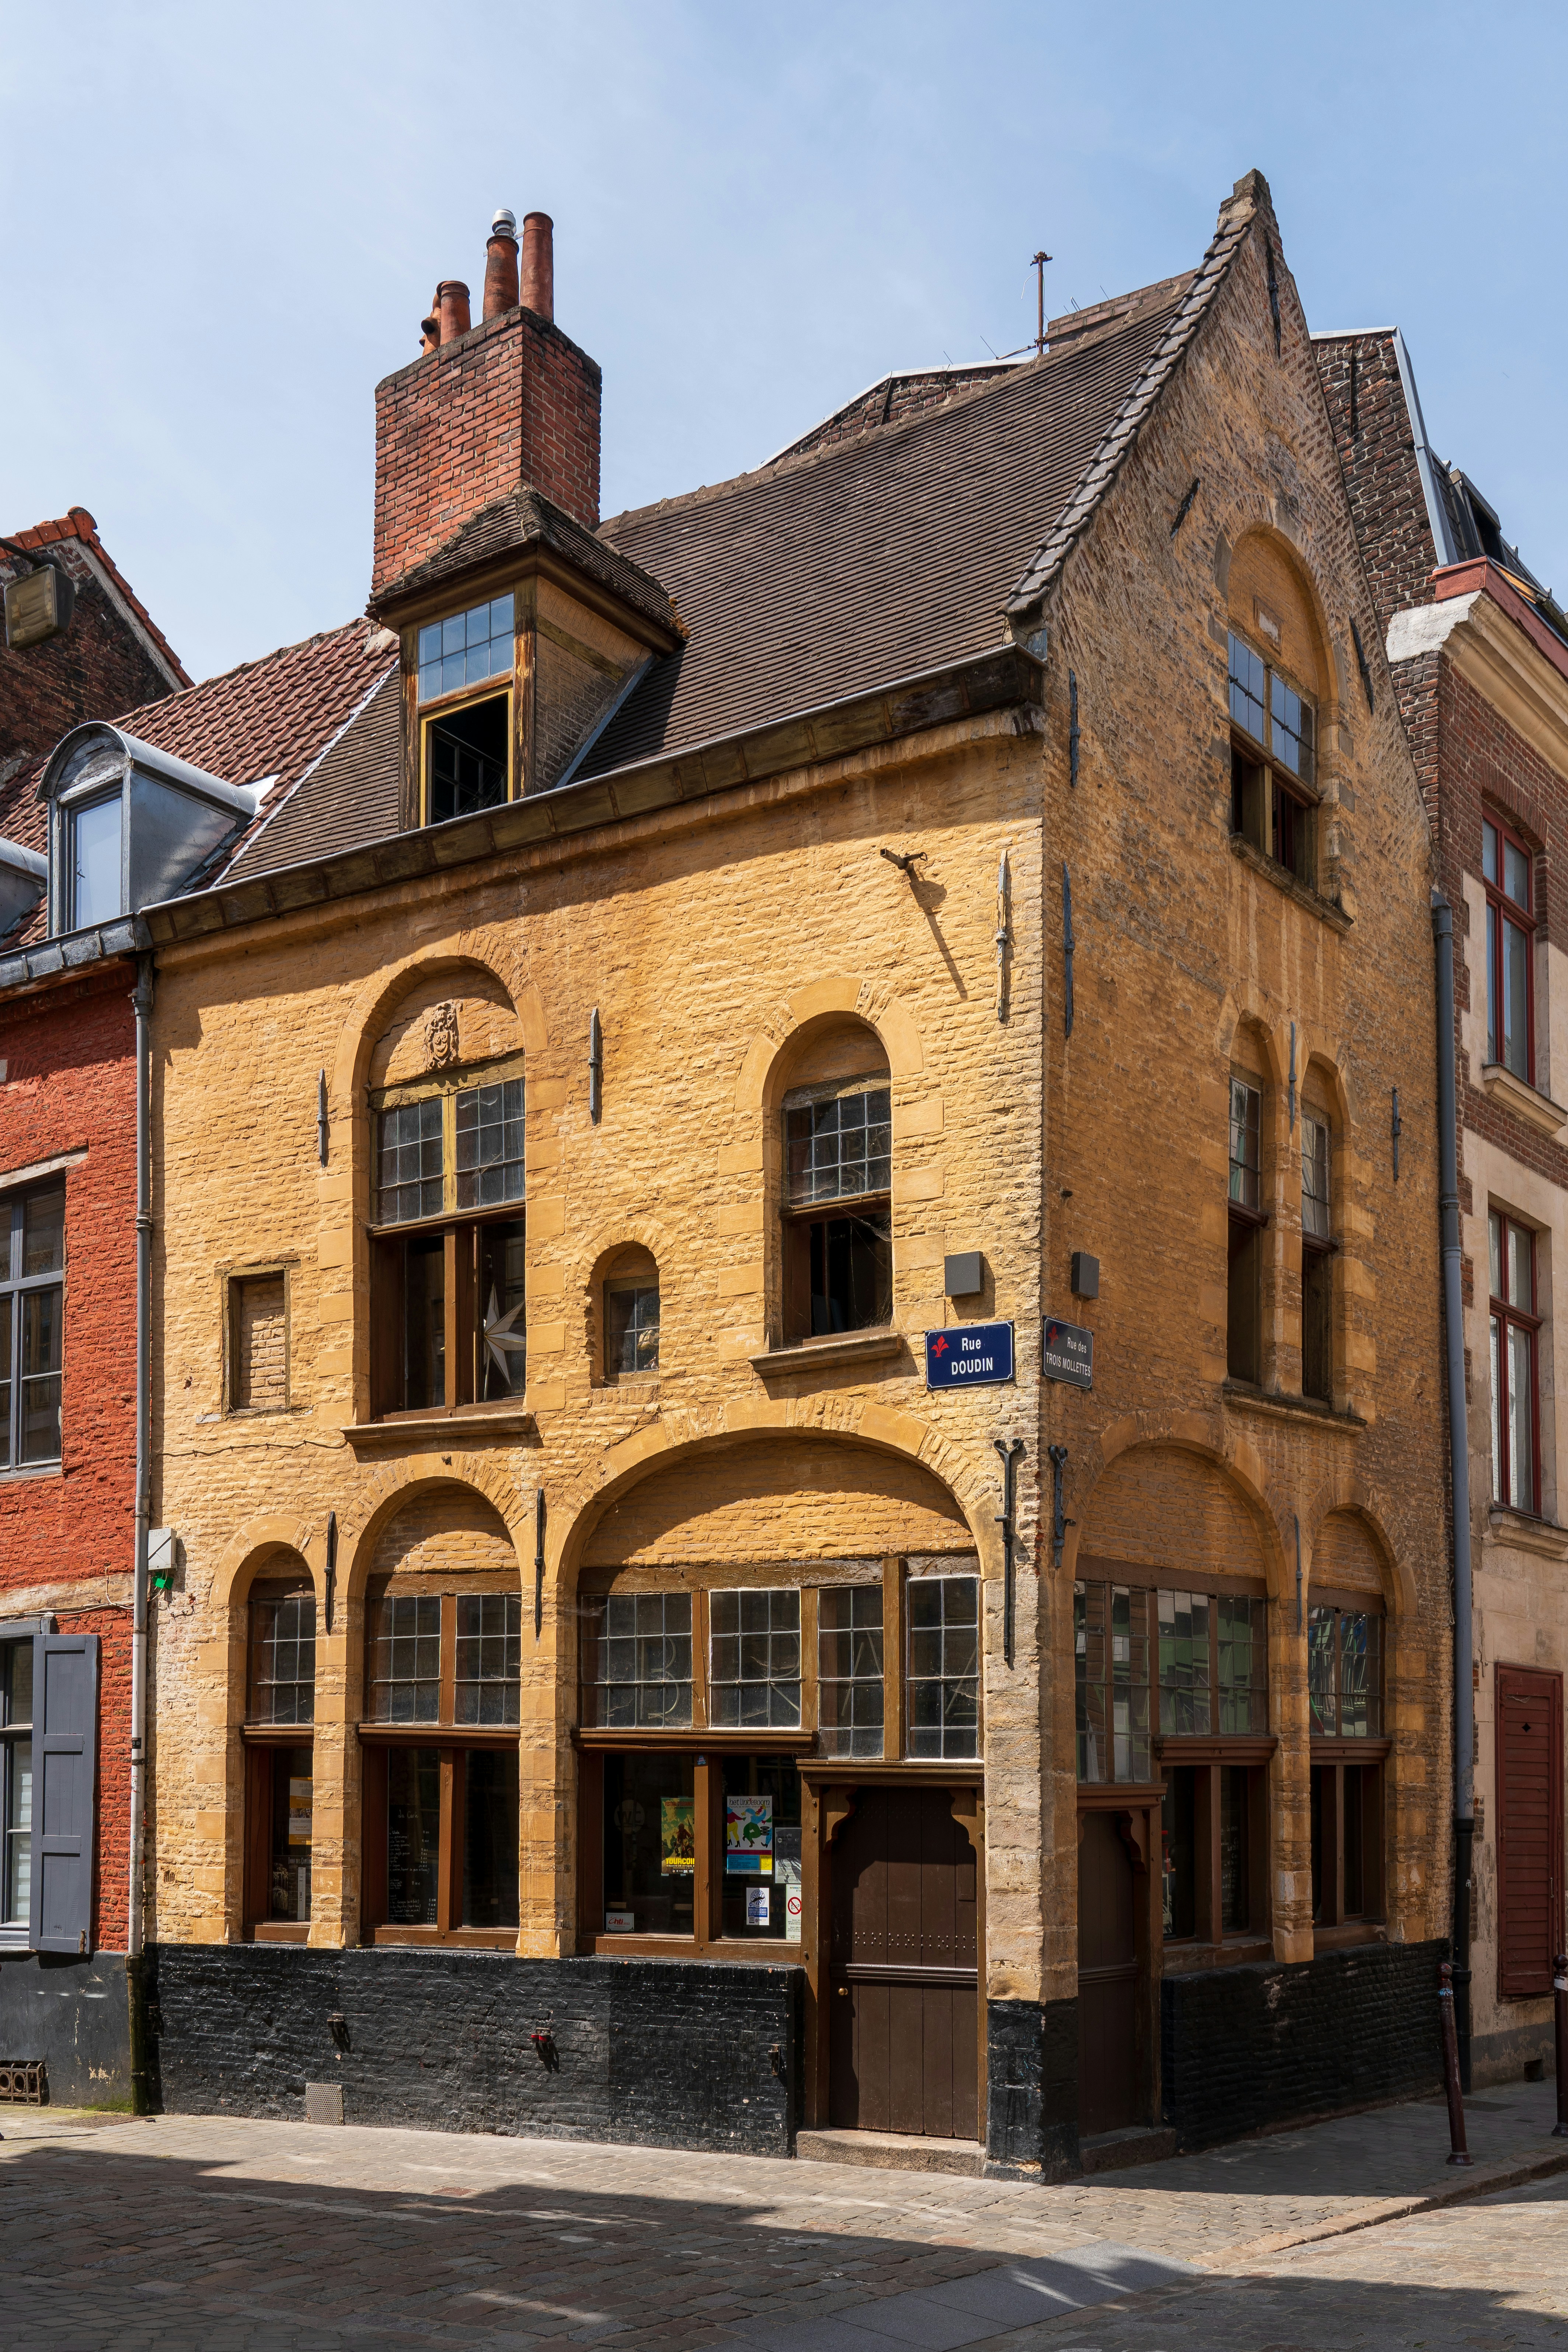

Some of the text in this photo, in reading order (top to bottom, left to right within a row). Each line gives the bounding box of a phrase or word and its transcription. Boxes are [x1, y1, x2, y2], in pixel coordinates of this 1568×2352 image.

[962, 1338, 981, 1351] Rue
[1067, 1337, 1087, 1353] Rue des
[951, 1357, 993, 1375] DOUDIN
[1046, 1352, 1091, 1377] TROIS MOLLETTES
[407, 1811, 419, 1819] Carte
